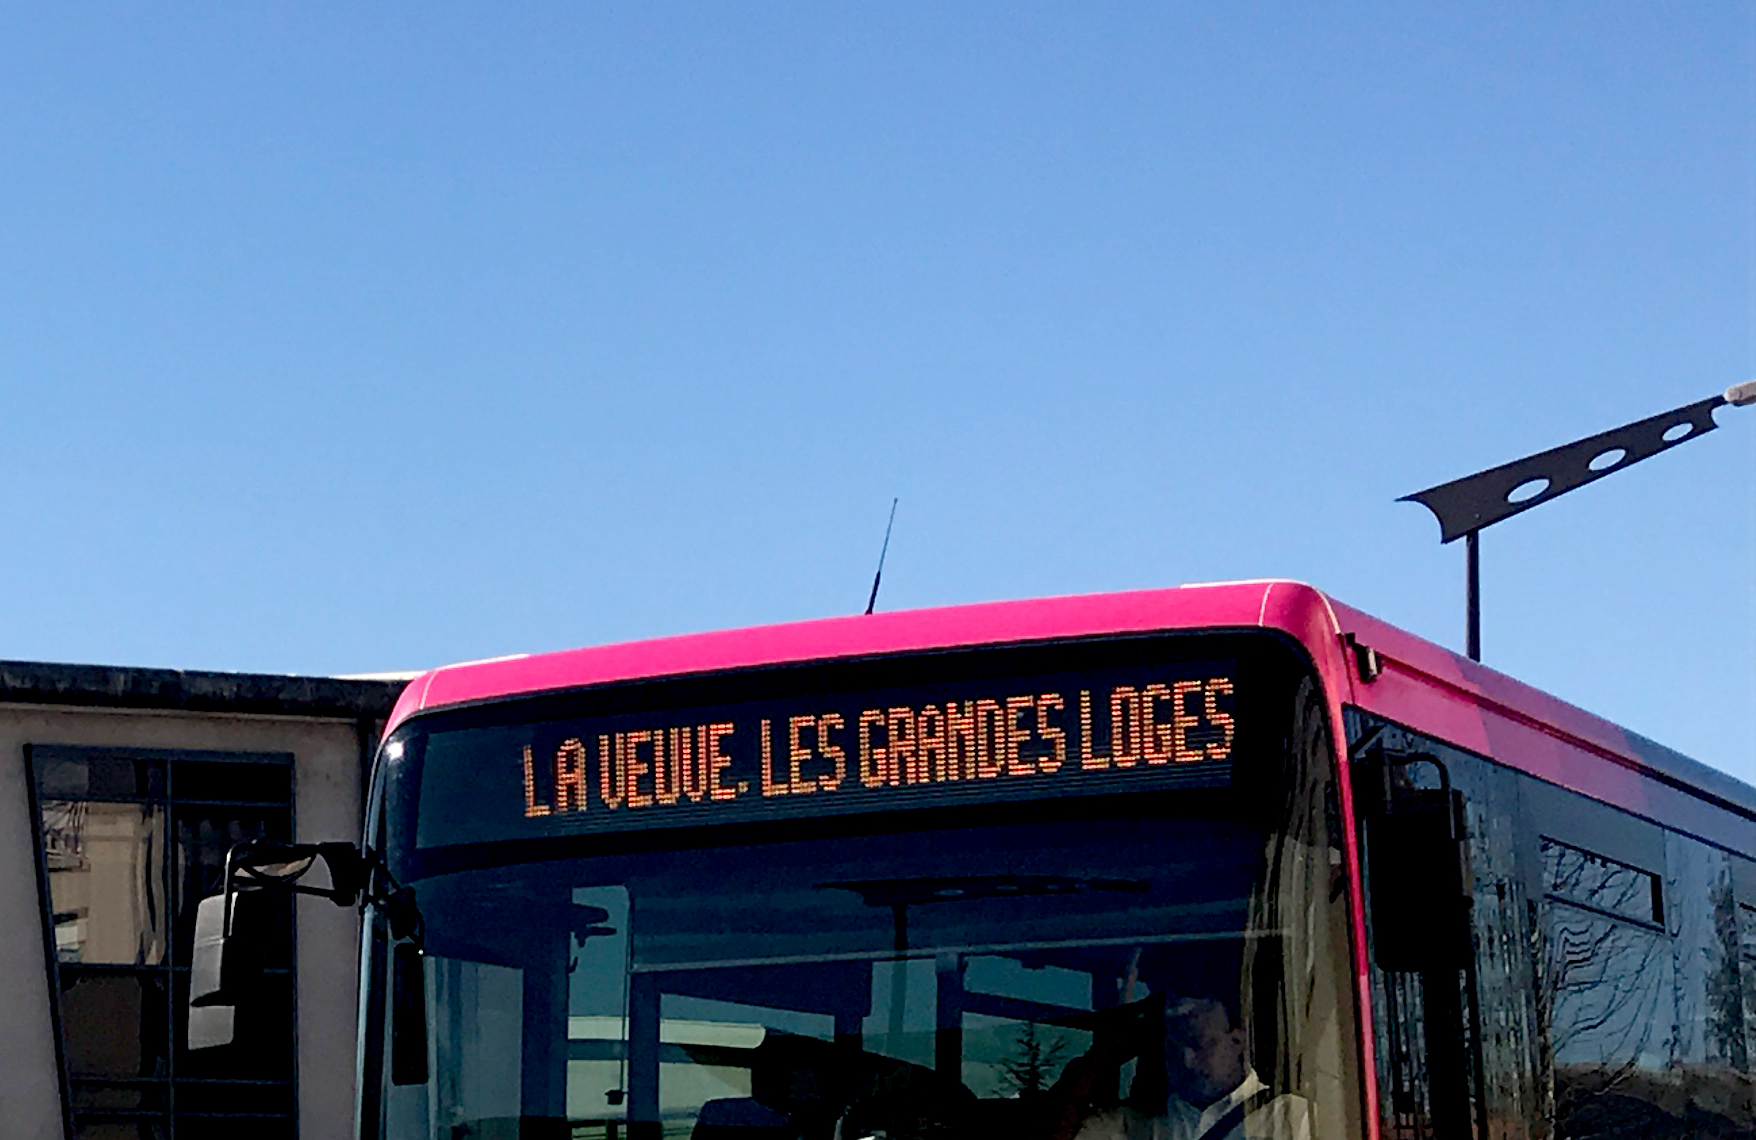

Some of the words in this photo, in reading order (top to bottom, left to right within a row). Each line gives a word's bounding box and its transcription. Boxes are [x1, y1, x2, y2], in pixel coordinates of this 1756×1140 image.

[523, 737, 587, 818] LA
[761, 712, 846, 797] LES
[859, 692, 1066, 789] GRANDES
[1080, 677, 1235, 771] LOGES
